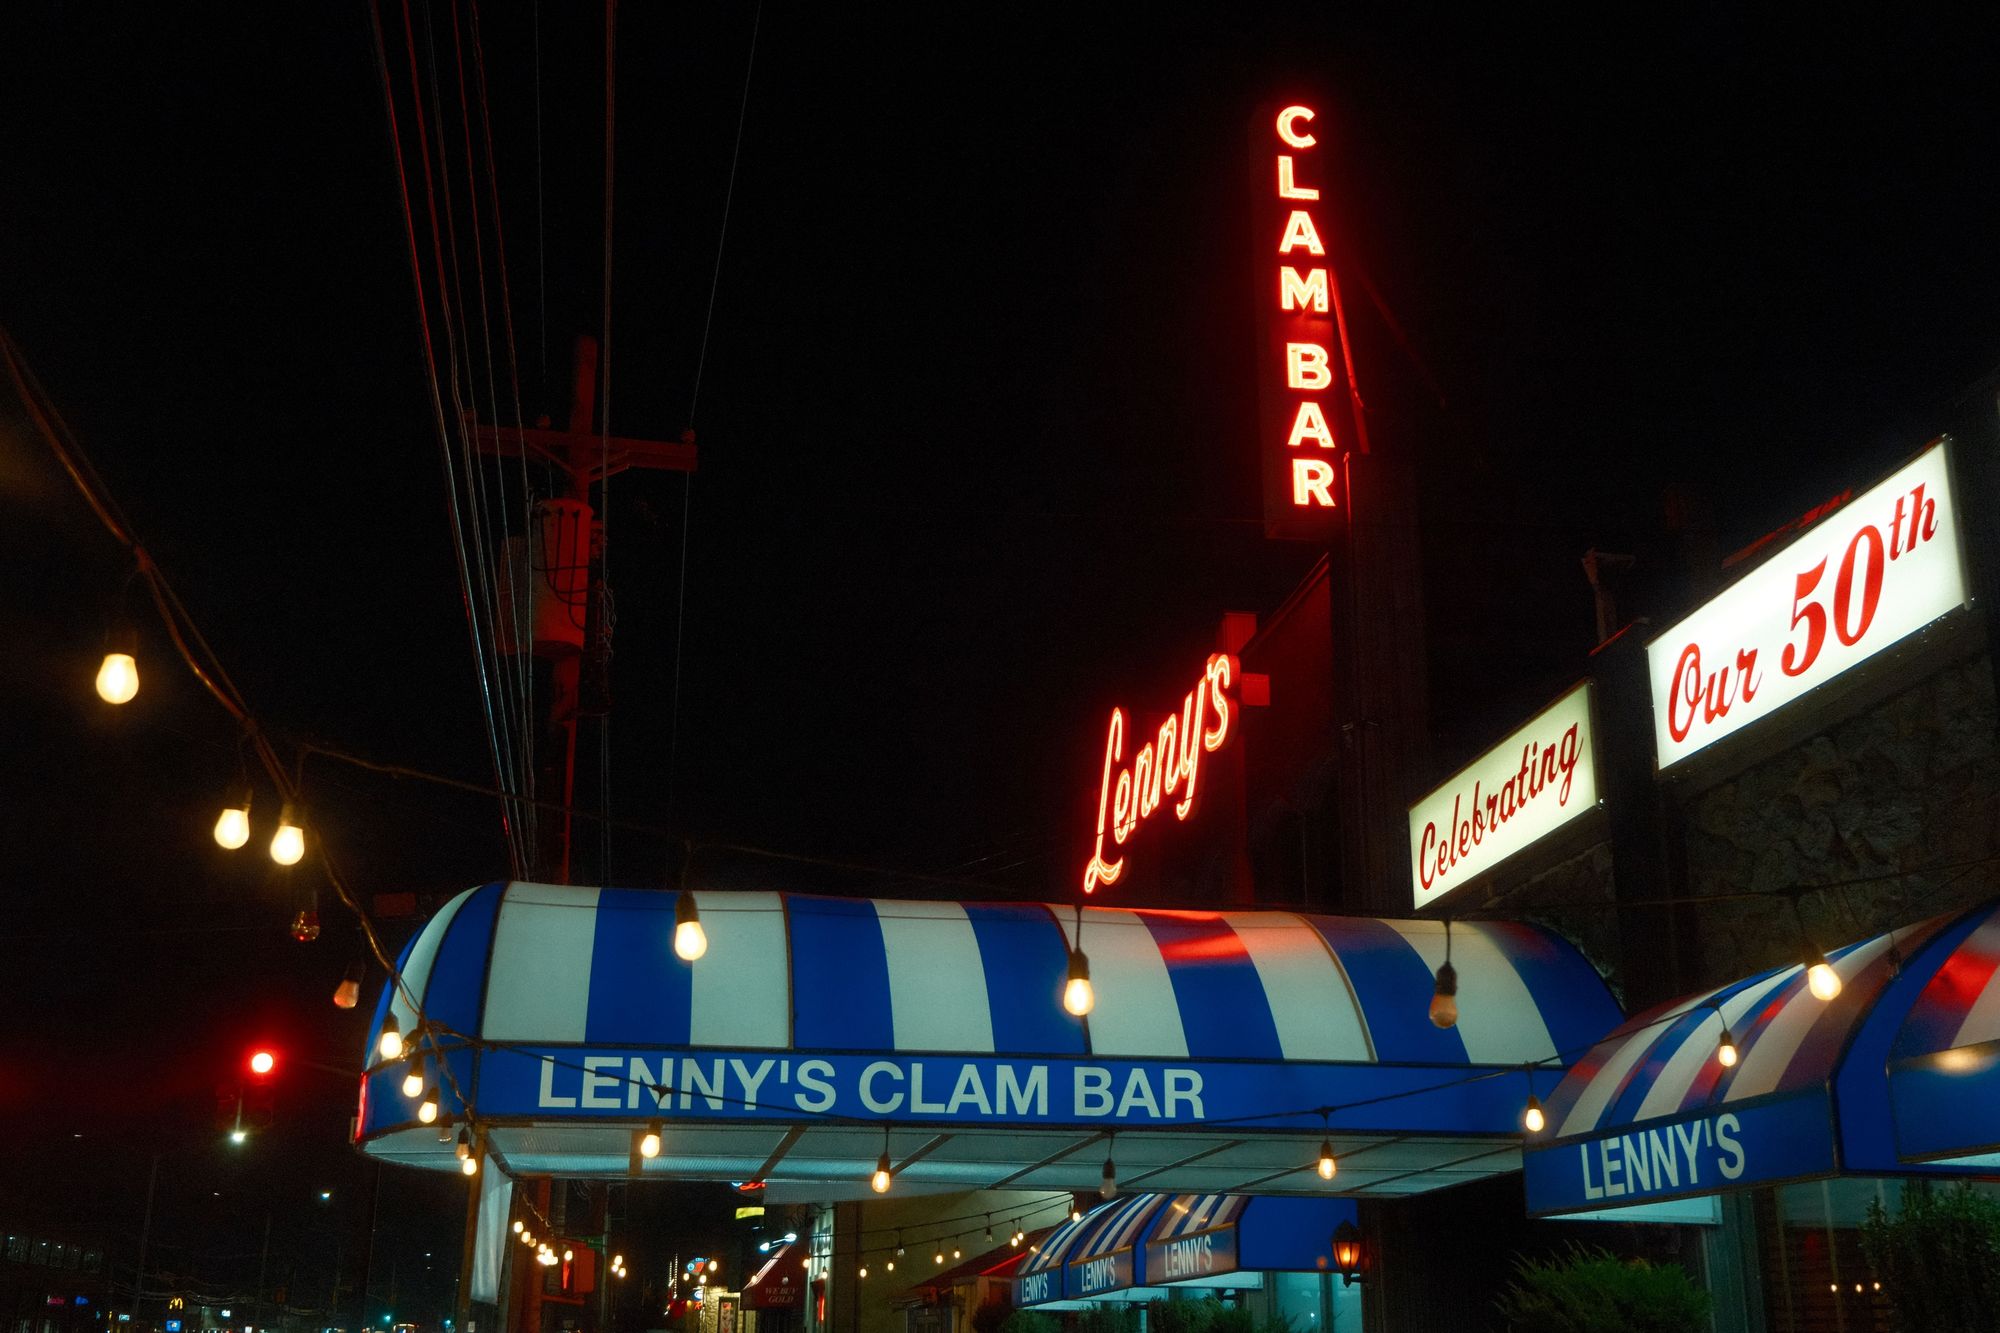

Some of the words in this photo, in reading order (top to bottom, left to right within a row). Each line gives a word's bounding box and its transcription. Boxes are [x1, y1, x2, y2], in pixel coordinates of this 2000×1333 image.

[1276, 105, 1329, 312] CLAM
[1286, 342, 1336, 507] BAR
[1668, 643, 1763, 743] Our
[1781, 482, 1939, 678] 50th
[1084, 654, 1231, 893] Lenny's
[1420, 721, 1584, 890] Celebrating
[538, 1055, 836, 1113] LENNY'S
[858, 1061, 1048, 1115] CLAM
[1074, 1066, 1205, 1119] BAR
[1580, 1112, 1745, 1200] LENNY'S
[768, 1295, 795, 1304] GOLD
[1021, 1272, 1048, 1303] LENNY'S
[1081, 1256, 1116, 1292] LENNY'S
[1164, 1234, 1213, 1278] LENNY'S
